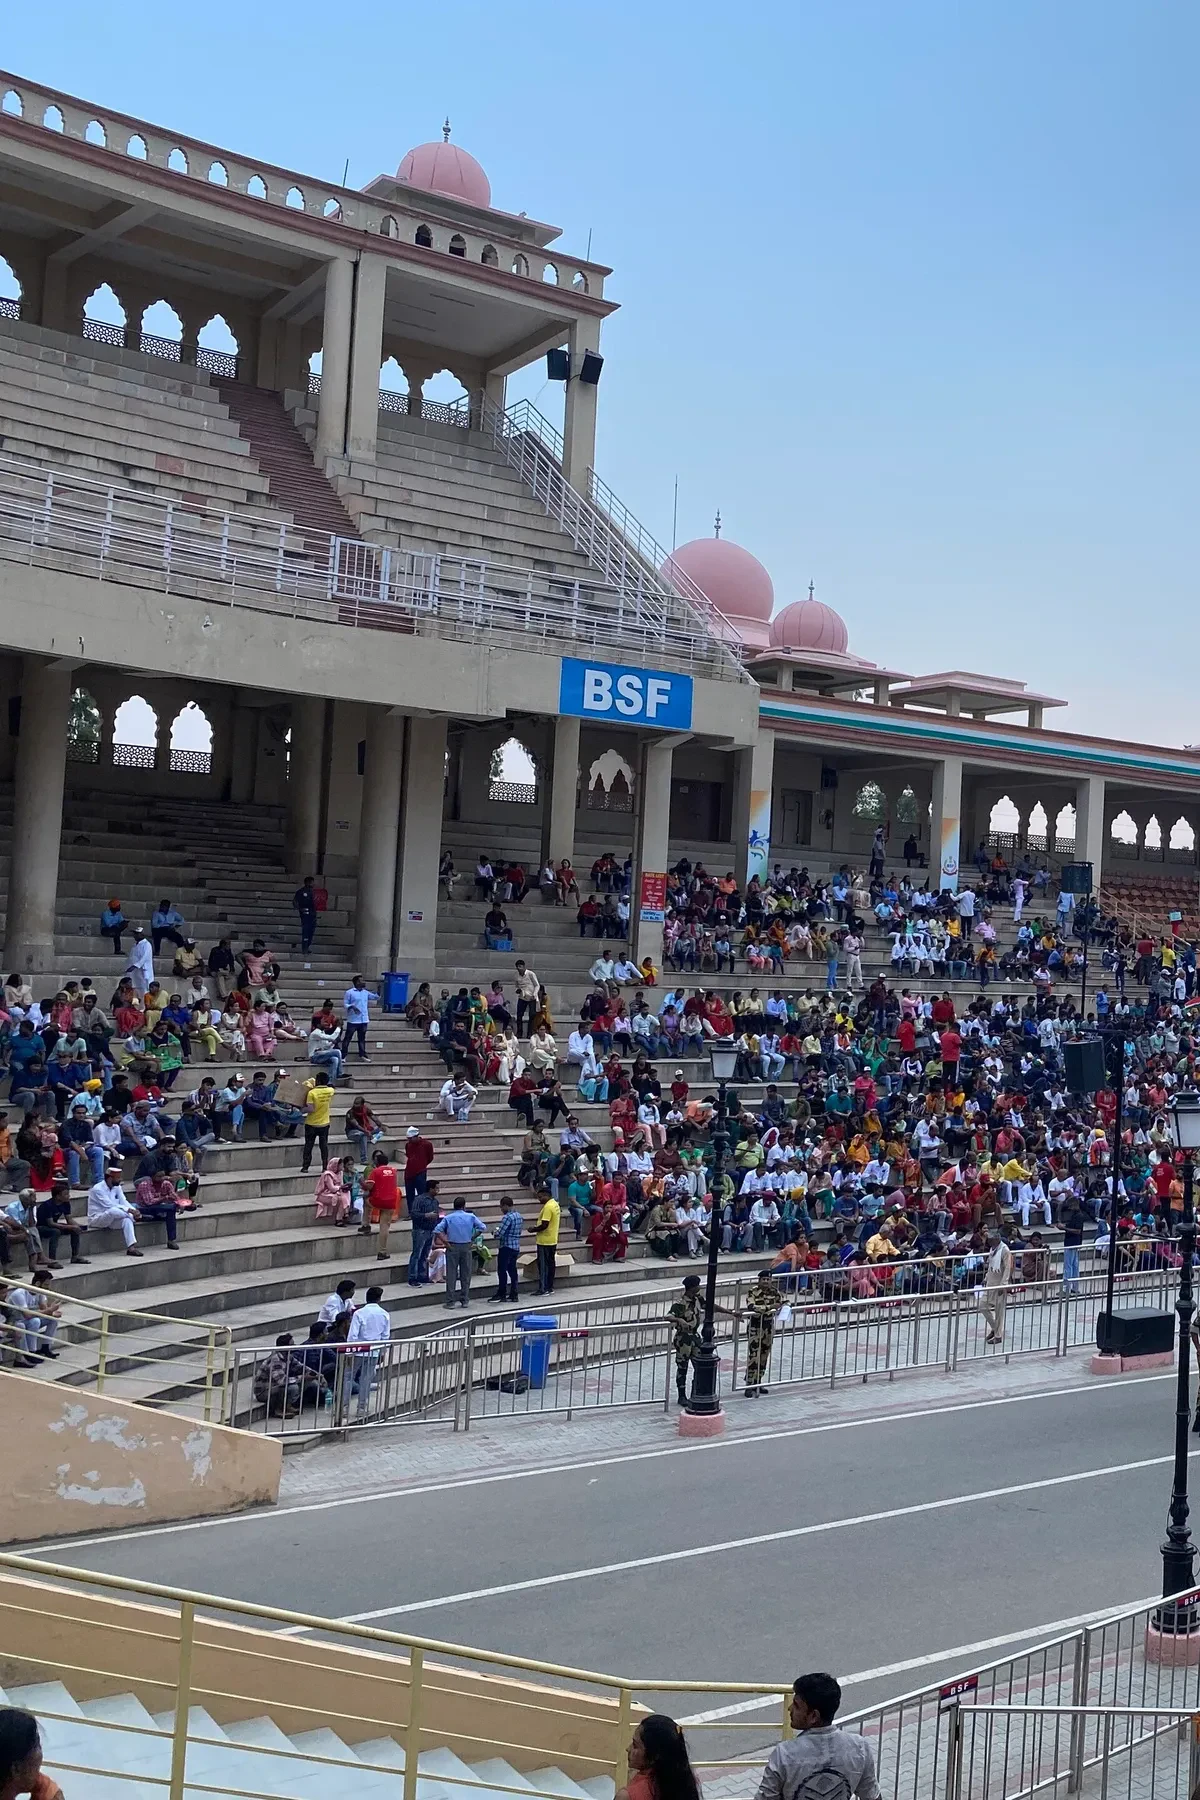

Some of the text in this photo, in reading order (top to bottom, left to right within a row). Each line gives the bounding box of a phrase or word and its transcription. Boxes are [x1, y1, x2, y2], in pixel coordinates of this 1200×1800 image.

[583, 668, 672, 718] BSF
[1184, 1594, 1199, 1606] BSF
[950, 1681, 969, 1695] BSF
